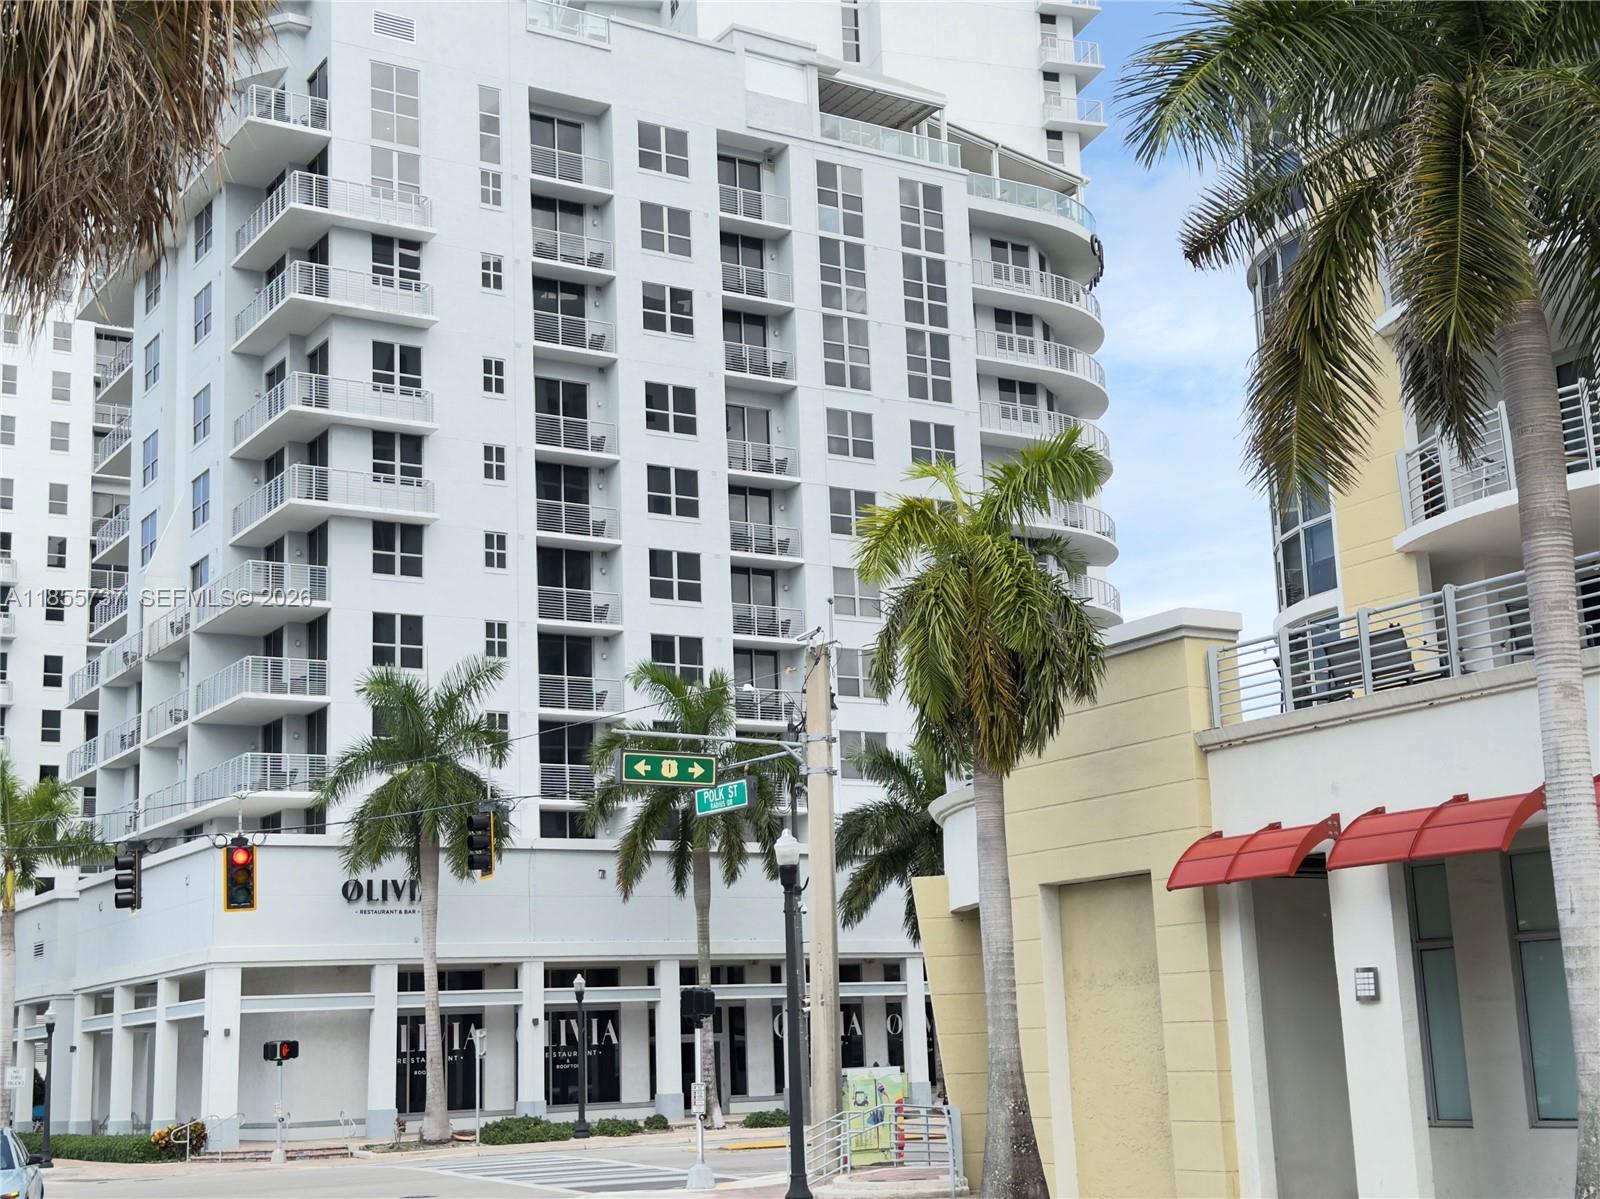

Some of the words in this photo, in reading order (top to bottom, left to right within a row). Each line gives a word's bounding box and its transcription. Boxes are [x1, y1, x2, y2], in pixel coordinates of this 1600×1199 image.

[703, 787, 725, 804] POLK
[727, 784, 738, 798] ST
[341, 878, 422, 904] ØLIVI
